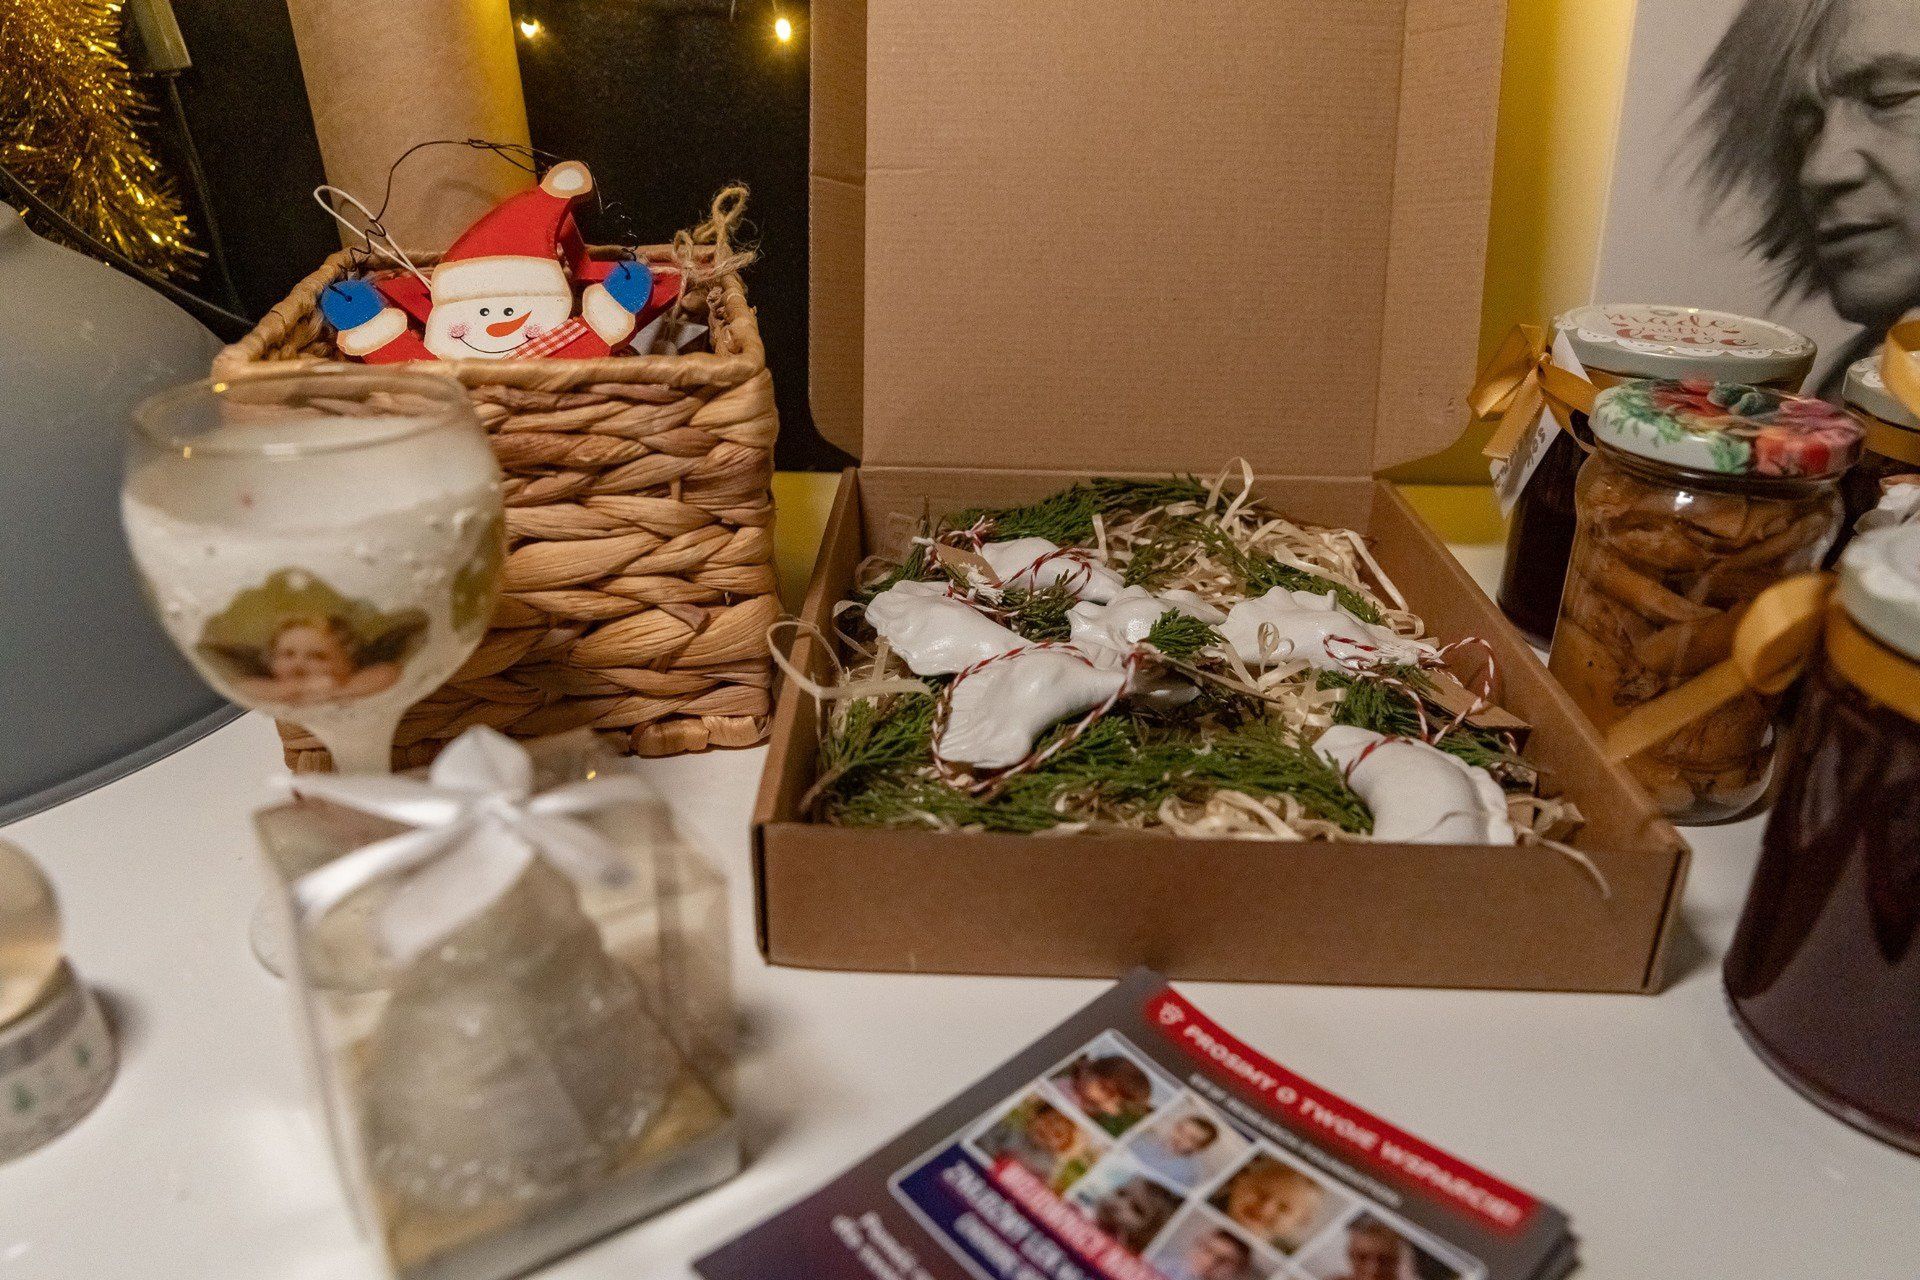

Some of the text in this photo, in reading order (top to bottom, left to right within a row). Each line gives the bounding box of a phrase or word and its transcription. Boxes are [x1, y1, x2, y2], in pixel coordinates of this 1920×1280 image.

[1182, 1023, 1278, 1092] PROSIMY
[1275, 1085, 1298, 1105] O
[1299, 1097, 1380, 1151] TWOJE
[1379, 1139, 1524, 1226] WSPARCIE!
